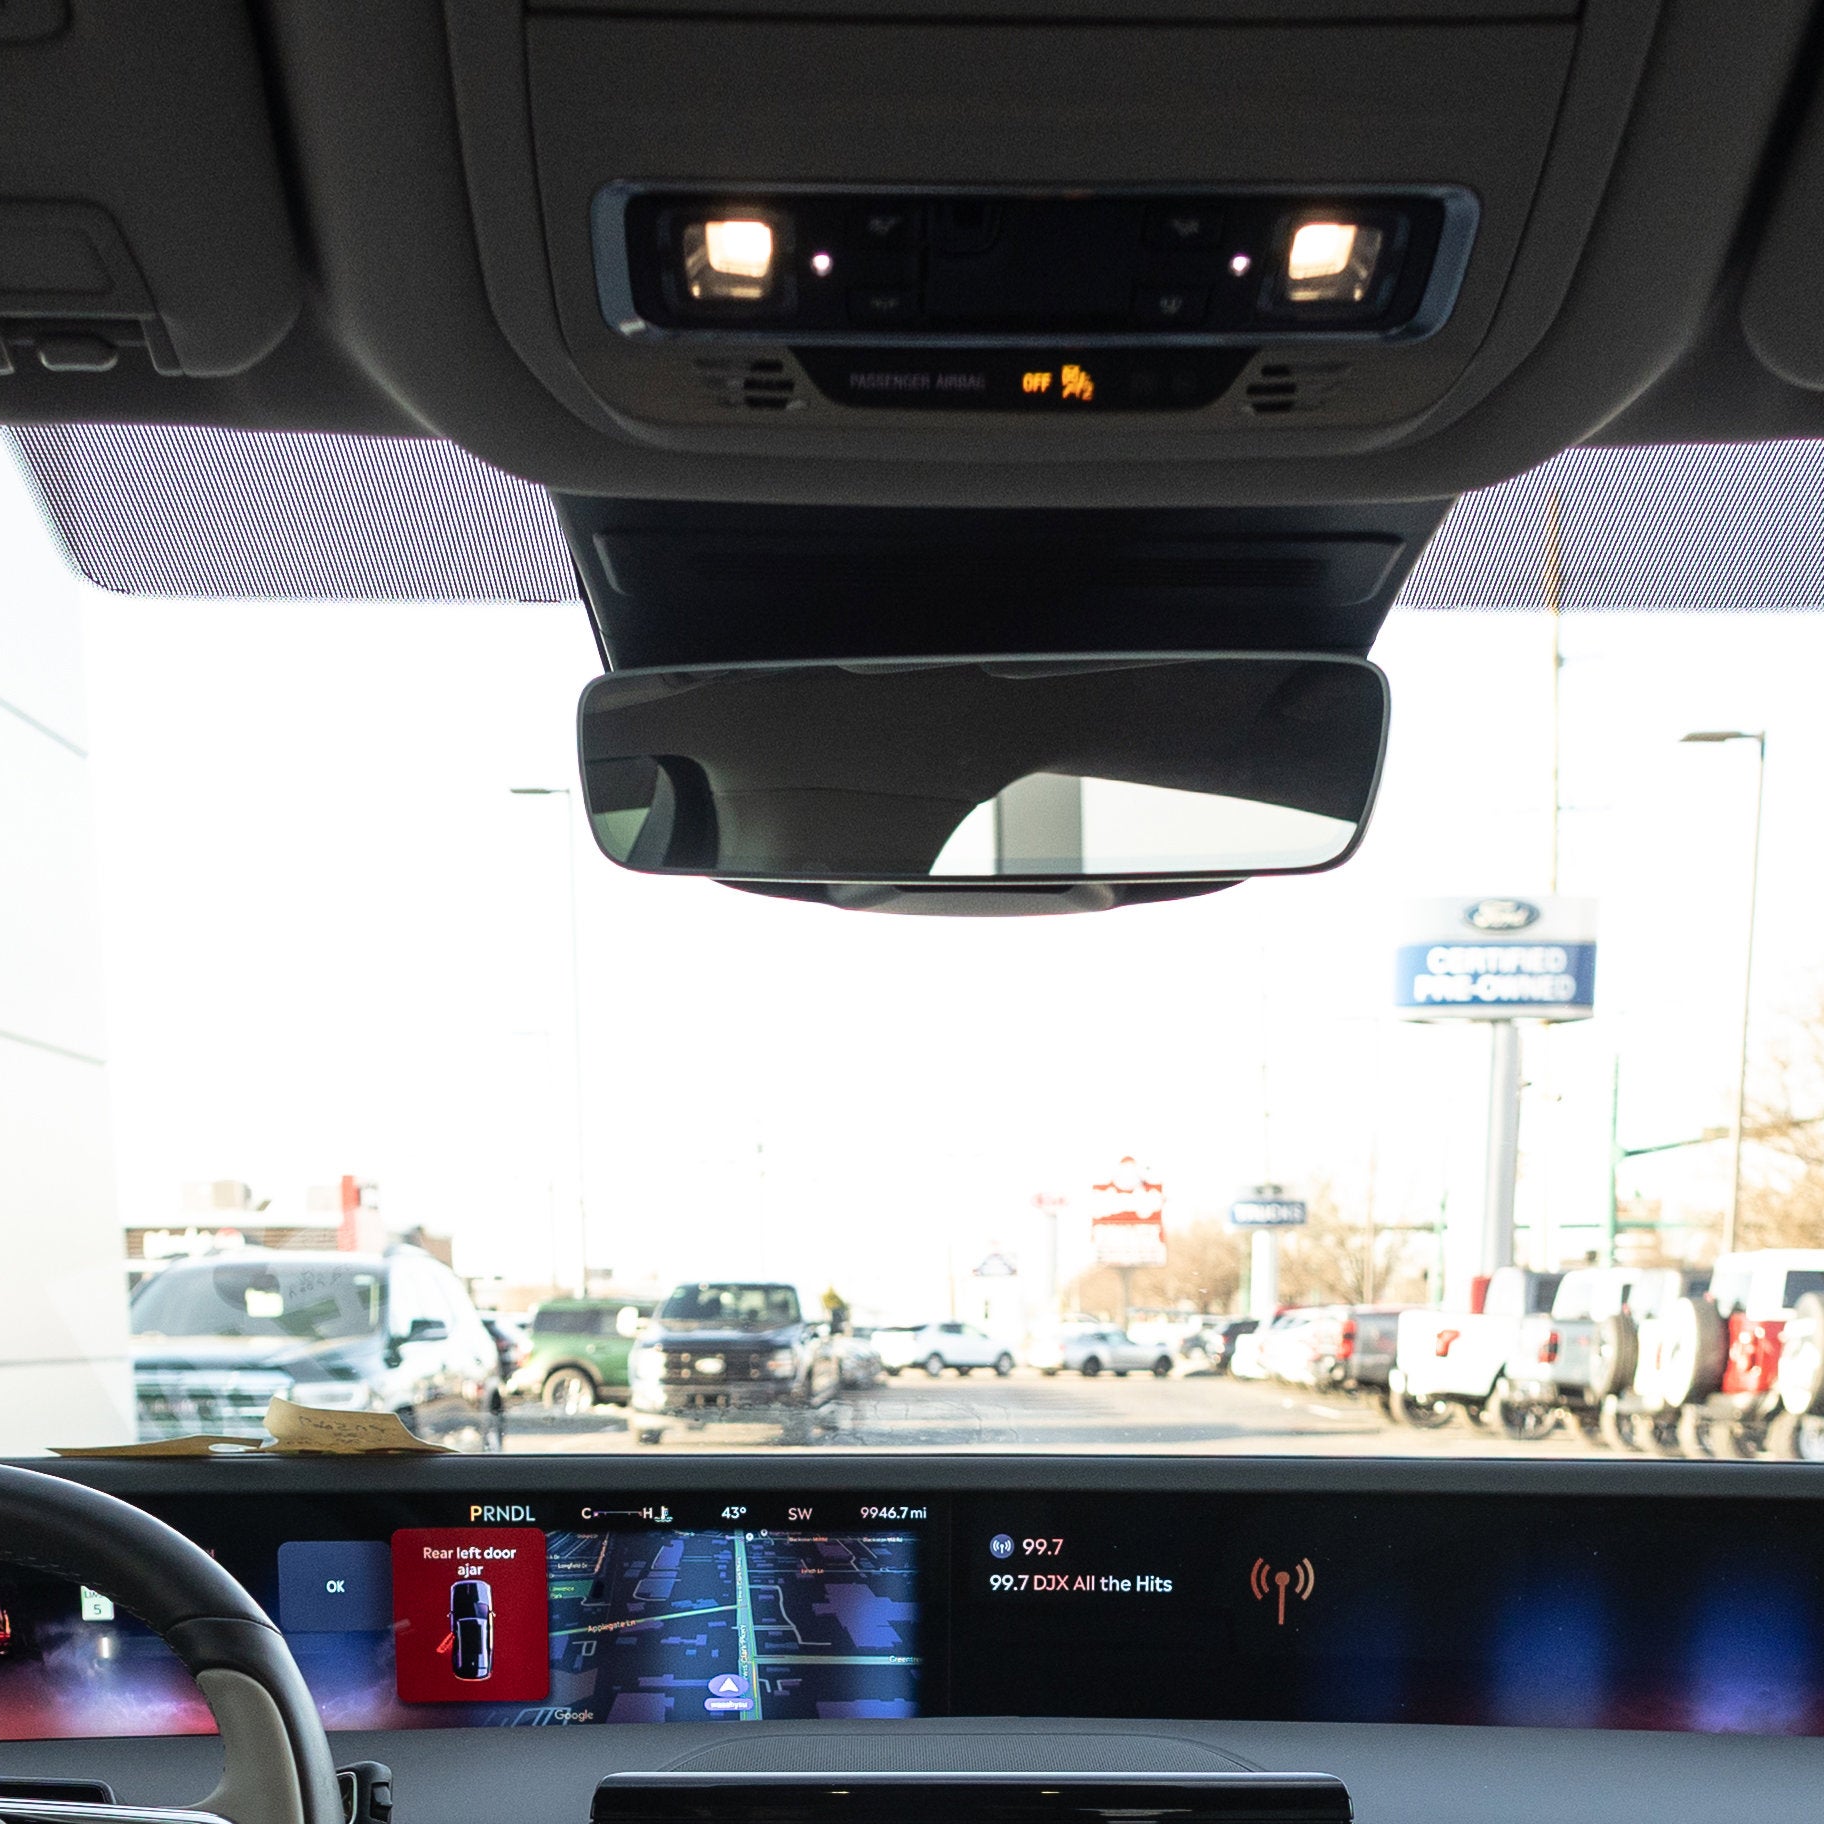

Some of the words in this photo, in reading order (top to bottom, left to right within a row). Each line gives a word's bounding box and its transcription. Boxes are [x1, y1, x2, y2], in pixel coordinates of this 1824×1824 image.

[1022, 371, 1053, 393] OFF
[581, 1507, 592, 1520] C
[642, 1507, 653, 1520] H
[721, 1506, 747, 1520] 43°
[788, 1507, 813, 1521] SW
[423, 1547, 453, 1559] Rear
[456, 1547, 480, 1559] left
[483, 1547, 516, 1560] door
[1022, 1538, 1064, 1556] 99.7
[457, 1563, 483, 1578] ajar
[326, 1580, 345, 1593] OK
[989, 1575, 1030, 1592] 99.7
[1033, 1574, 1070, 1592] DJX
[1073, 1575, 1096, 1592] All
[1099, 1575, 1132, 1592] the
[1136, 1576, 1173, 1593] Hits
[554, 1709, 594, 1723] Google
